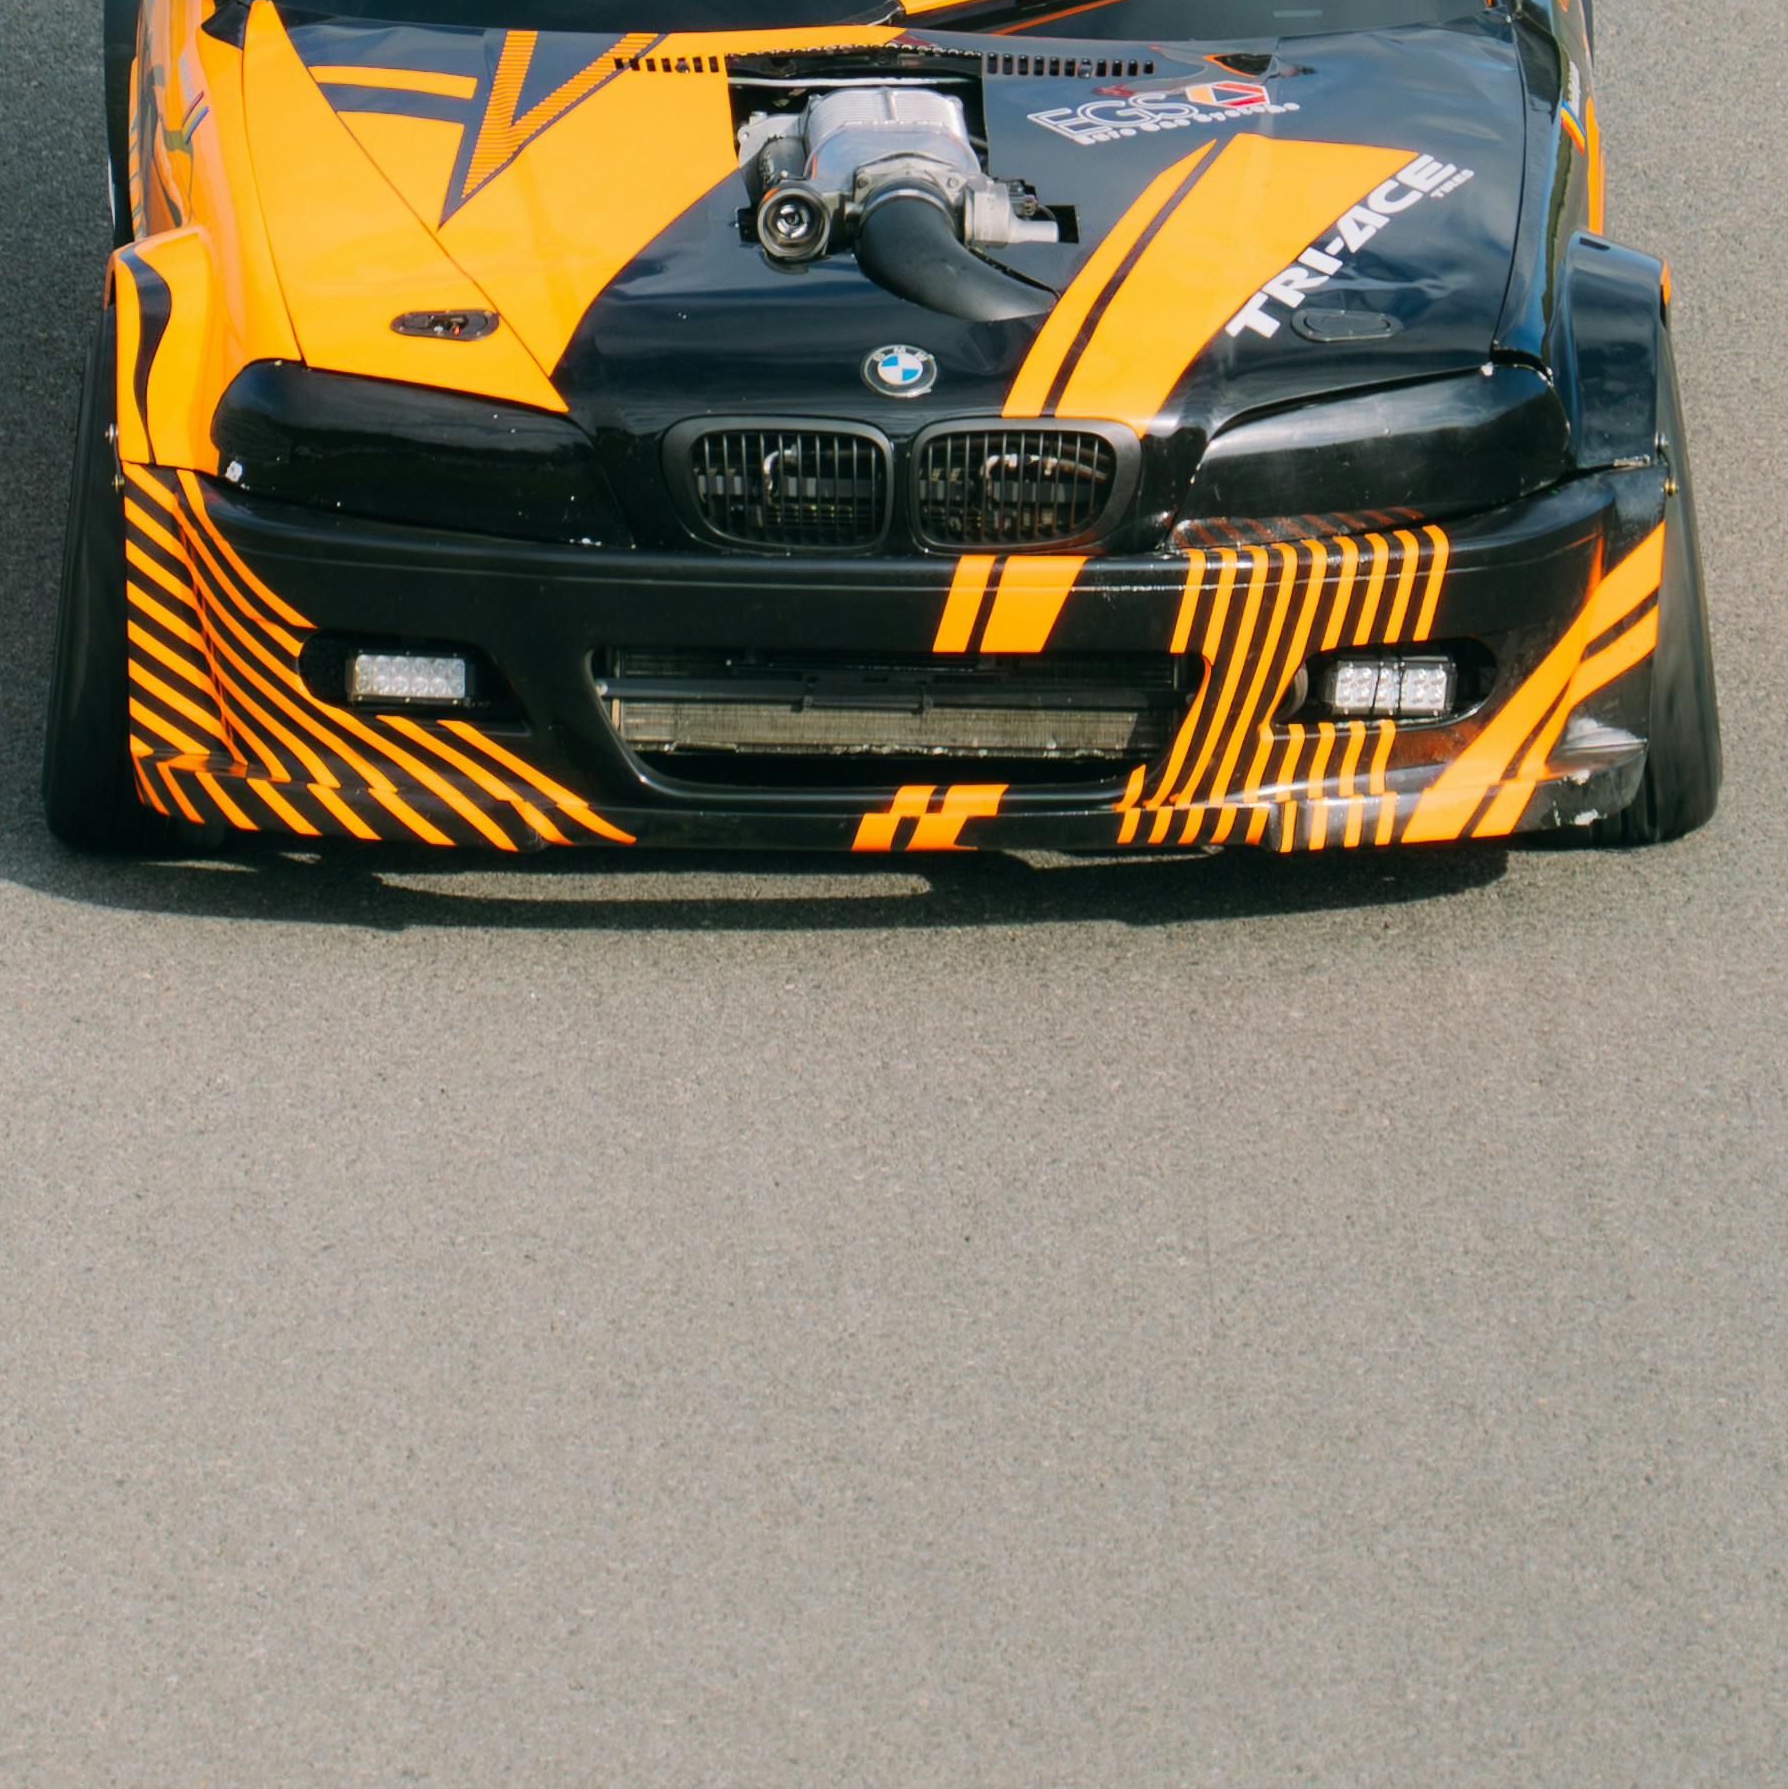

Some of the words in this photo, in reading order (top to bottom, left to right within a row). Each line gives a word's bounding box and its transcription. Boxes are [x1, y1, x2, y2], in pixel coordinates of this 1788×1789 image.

[1027, 92, 1199, 138] EGS
[1430, 168, 1475, 199] TIRES
[1225, 153, 1457, 339] TRI-ACE
